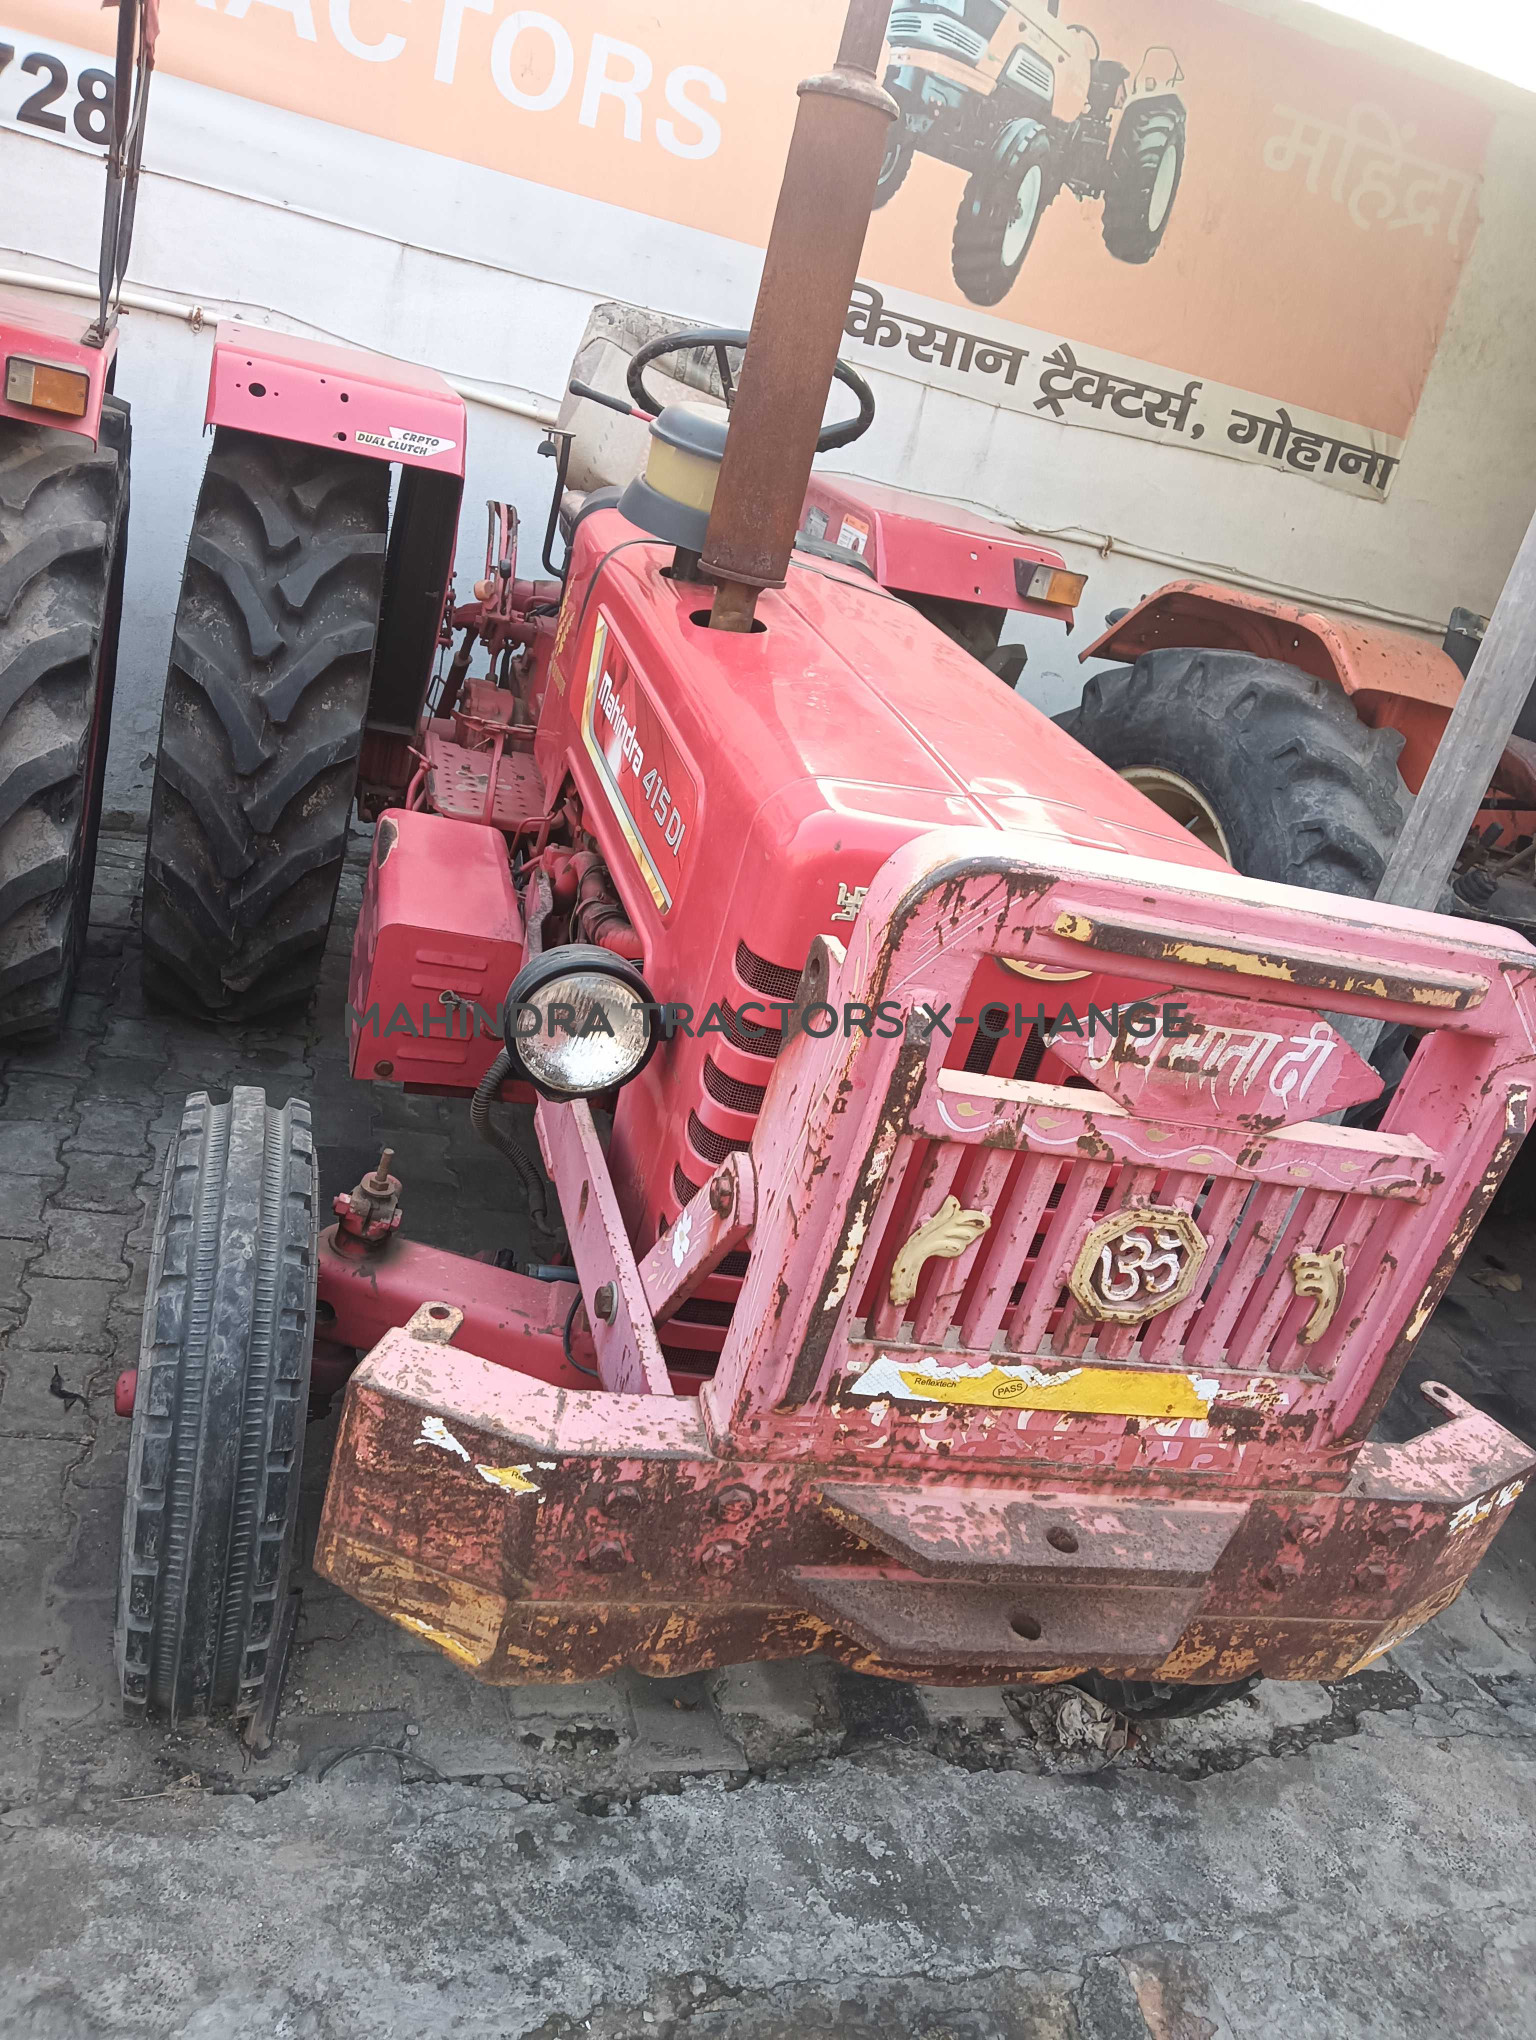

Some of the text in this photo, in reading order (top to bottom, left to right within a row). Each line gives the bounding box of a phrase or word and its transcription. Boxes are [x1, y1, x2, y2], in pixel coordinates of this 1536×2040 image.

[0, 42, 117, 146] 28
[1263, 102, 1482, 246] महिंद्रा
[357, 433, 428, 455] DUAL CLUTCH
[402, 432, 440, 447] CRPTO
[1032, 342, 1205, 440] ट्रैक्टर्स,
[1227, 407, 1400, 490] गोहाना
[642, 768, 672, 828] 415
[664, 807, 686, 856] DI
[1269, 1021, 1339, 1110] दी
[914, 1377, 1023, 1396] Reflextech PASS
